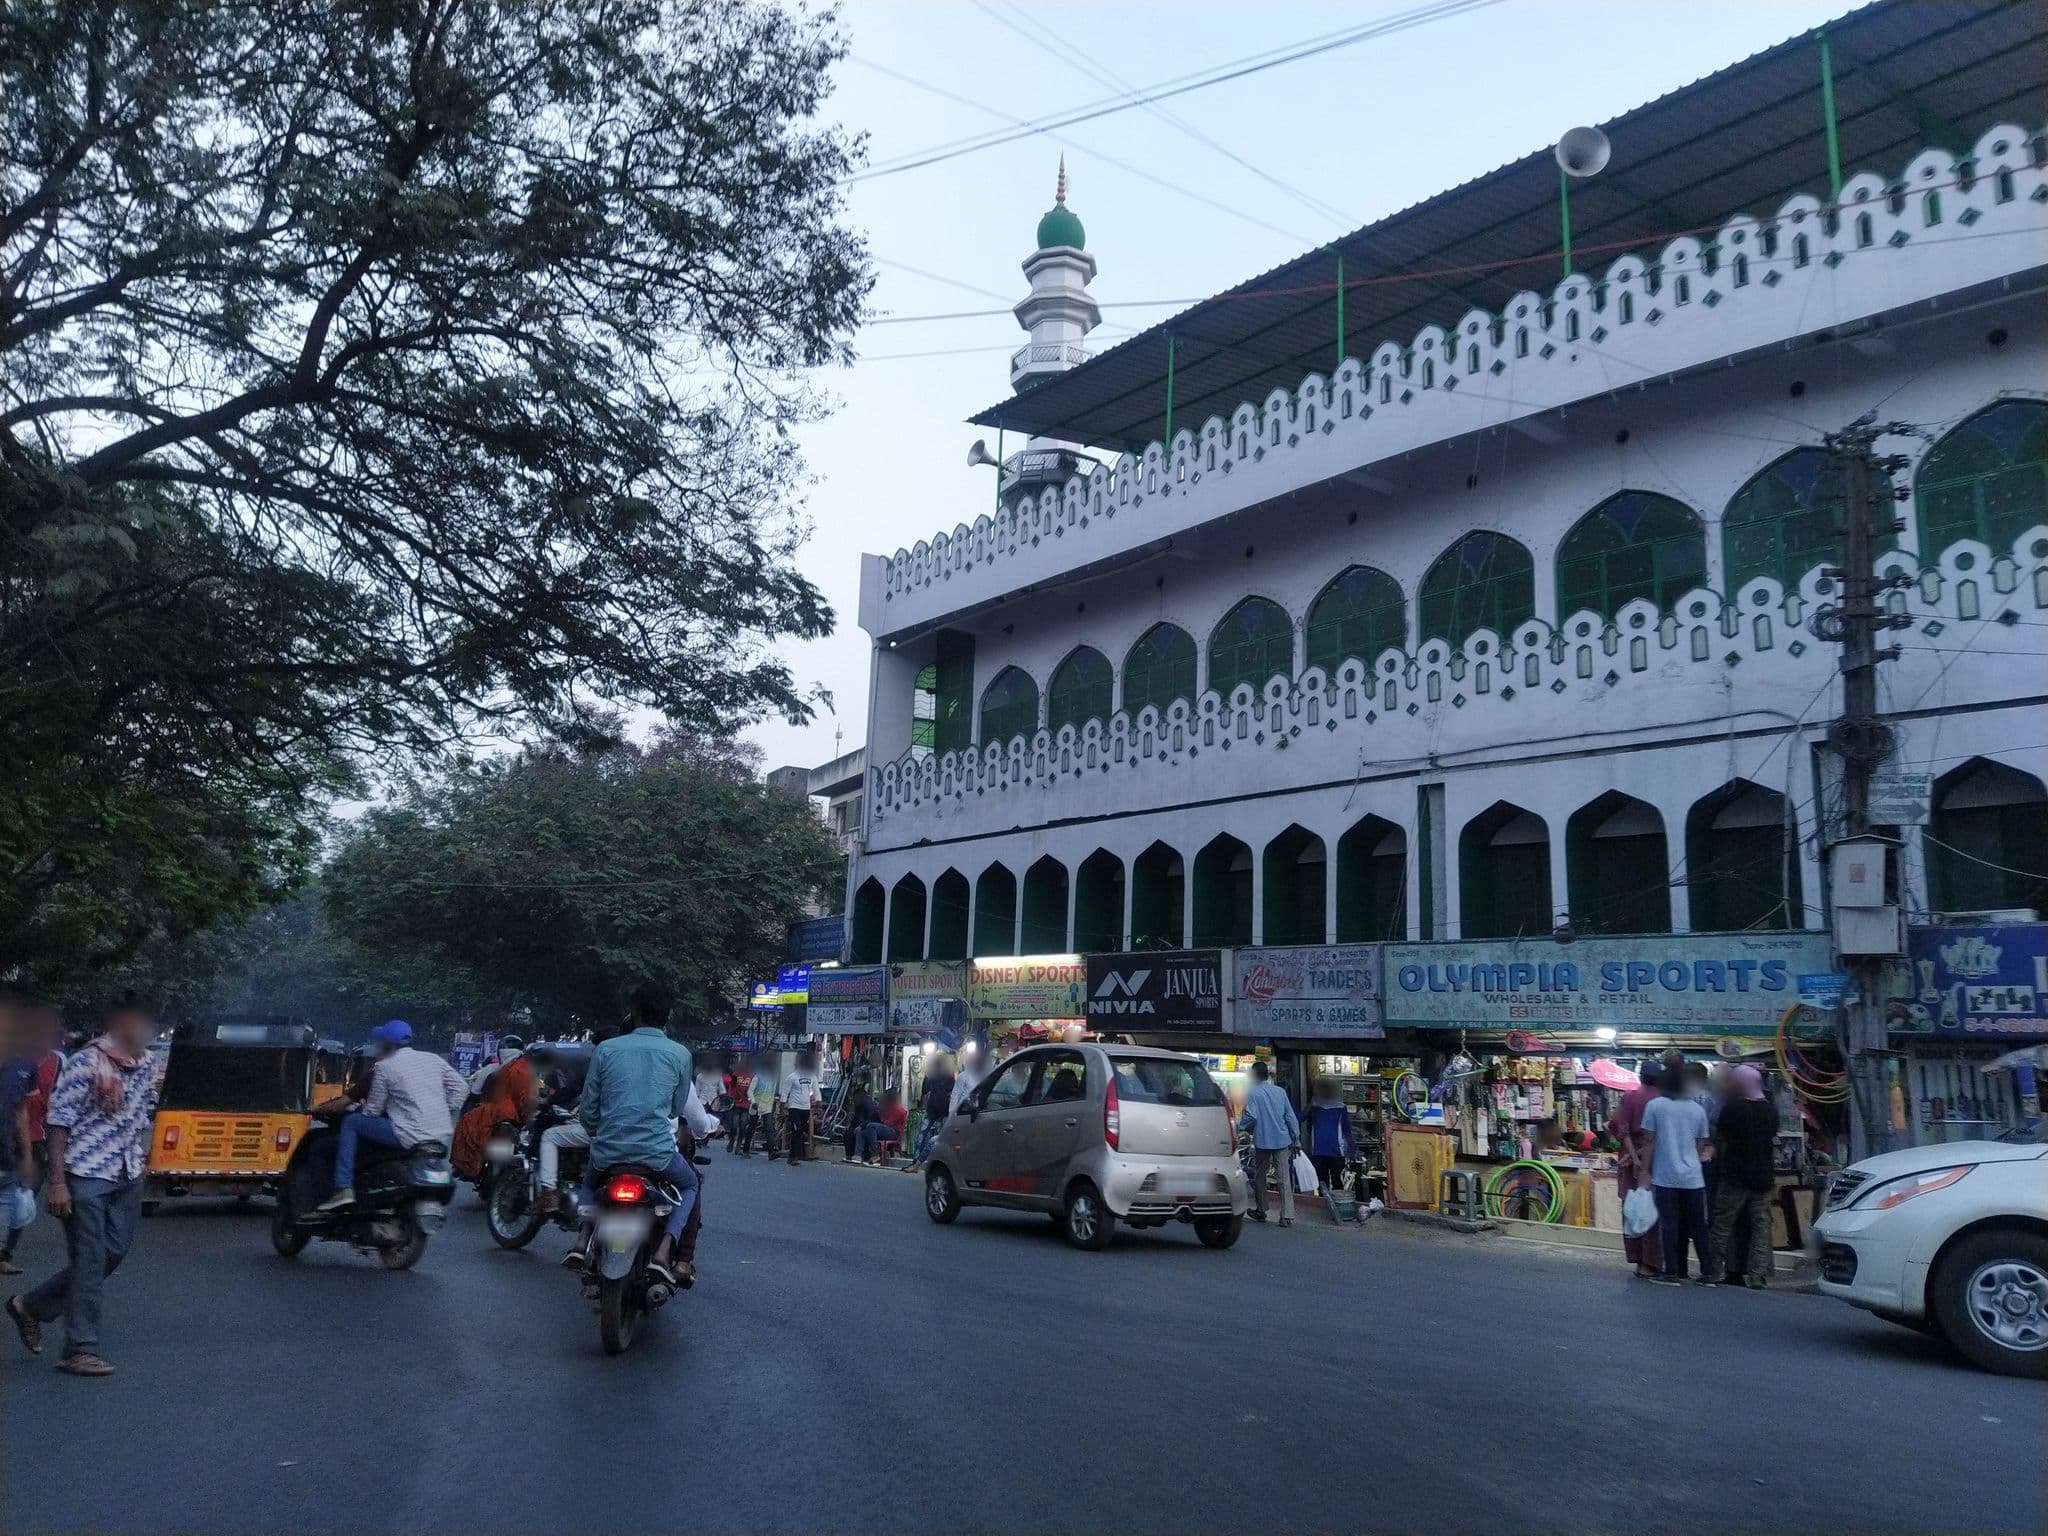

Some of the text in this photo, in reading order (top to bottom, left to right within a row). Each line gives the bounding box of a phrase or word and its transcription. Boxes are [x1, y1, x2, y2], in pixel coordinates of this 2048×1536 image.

[970, 965, 1087, 985] DISNEY SPORTS
[1398, 961, 1579, 993] OLYMPIA
[1600, 959, 1788, 993] SPORTS
[1164, 968, 1218, 999] JANJUA
[1194, 997, 1219, 1009] SPORTS
[1484, 993, 1651, 1005] WHOLESALE & RETAIL
[1088, 1000, 1156, 1014] NIVIA
[1271, 1007, 1367, 1022] SPORTS & GAMES
